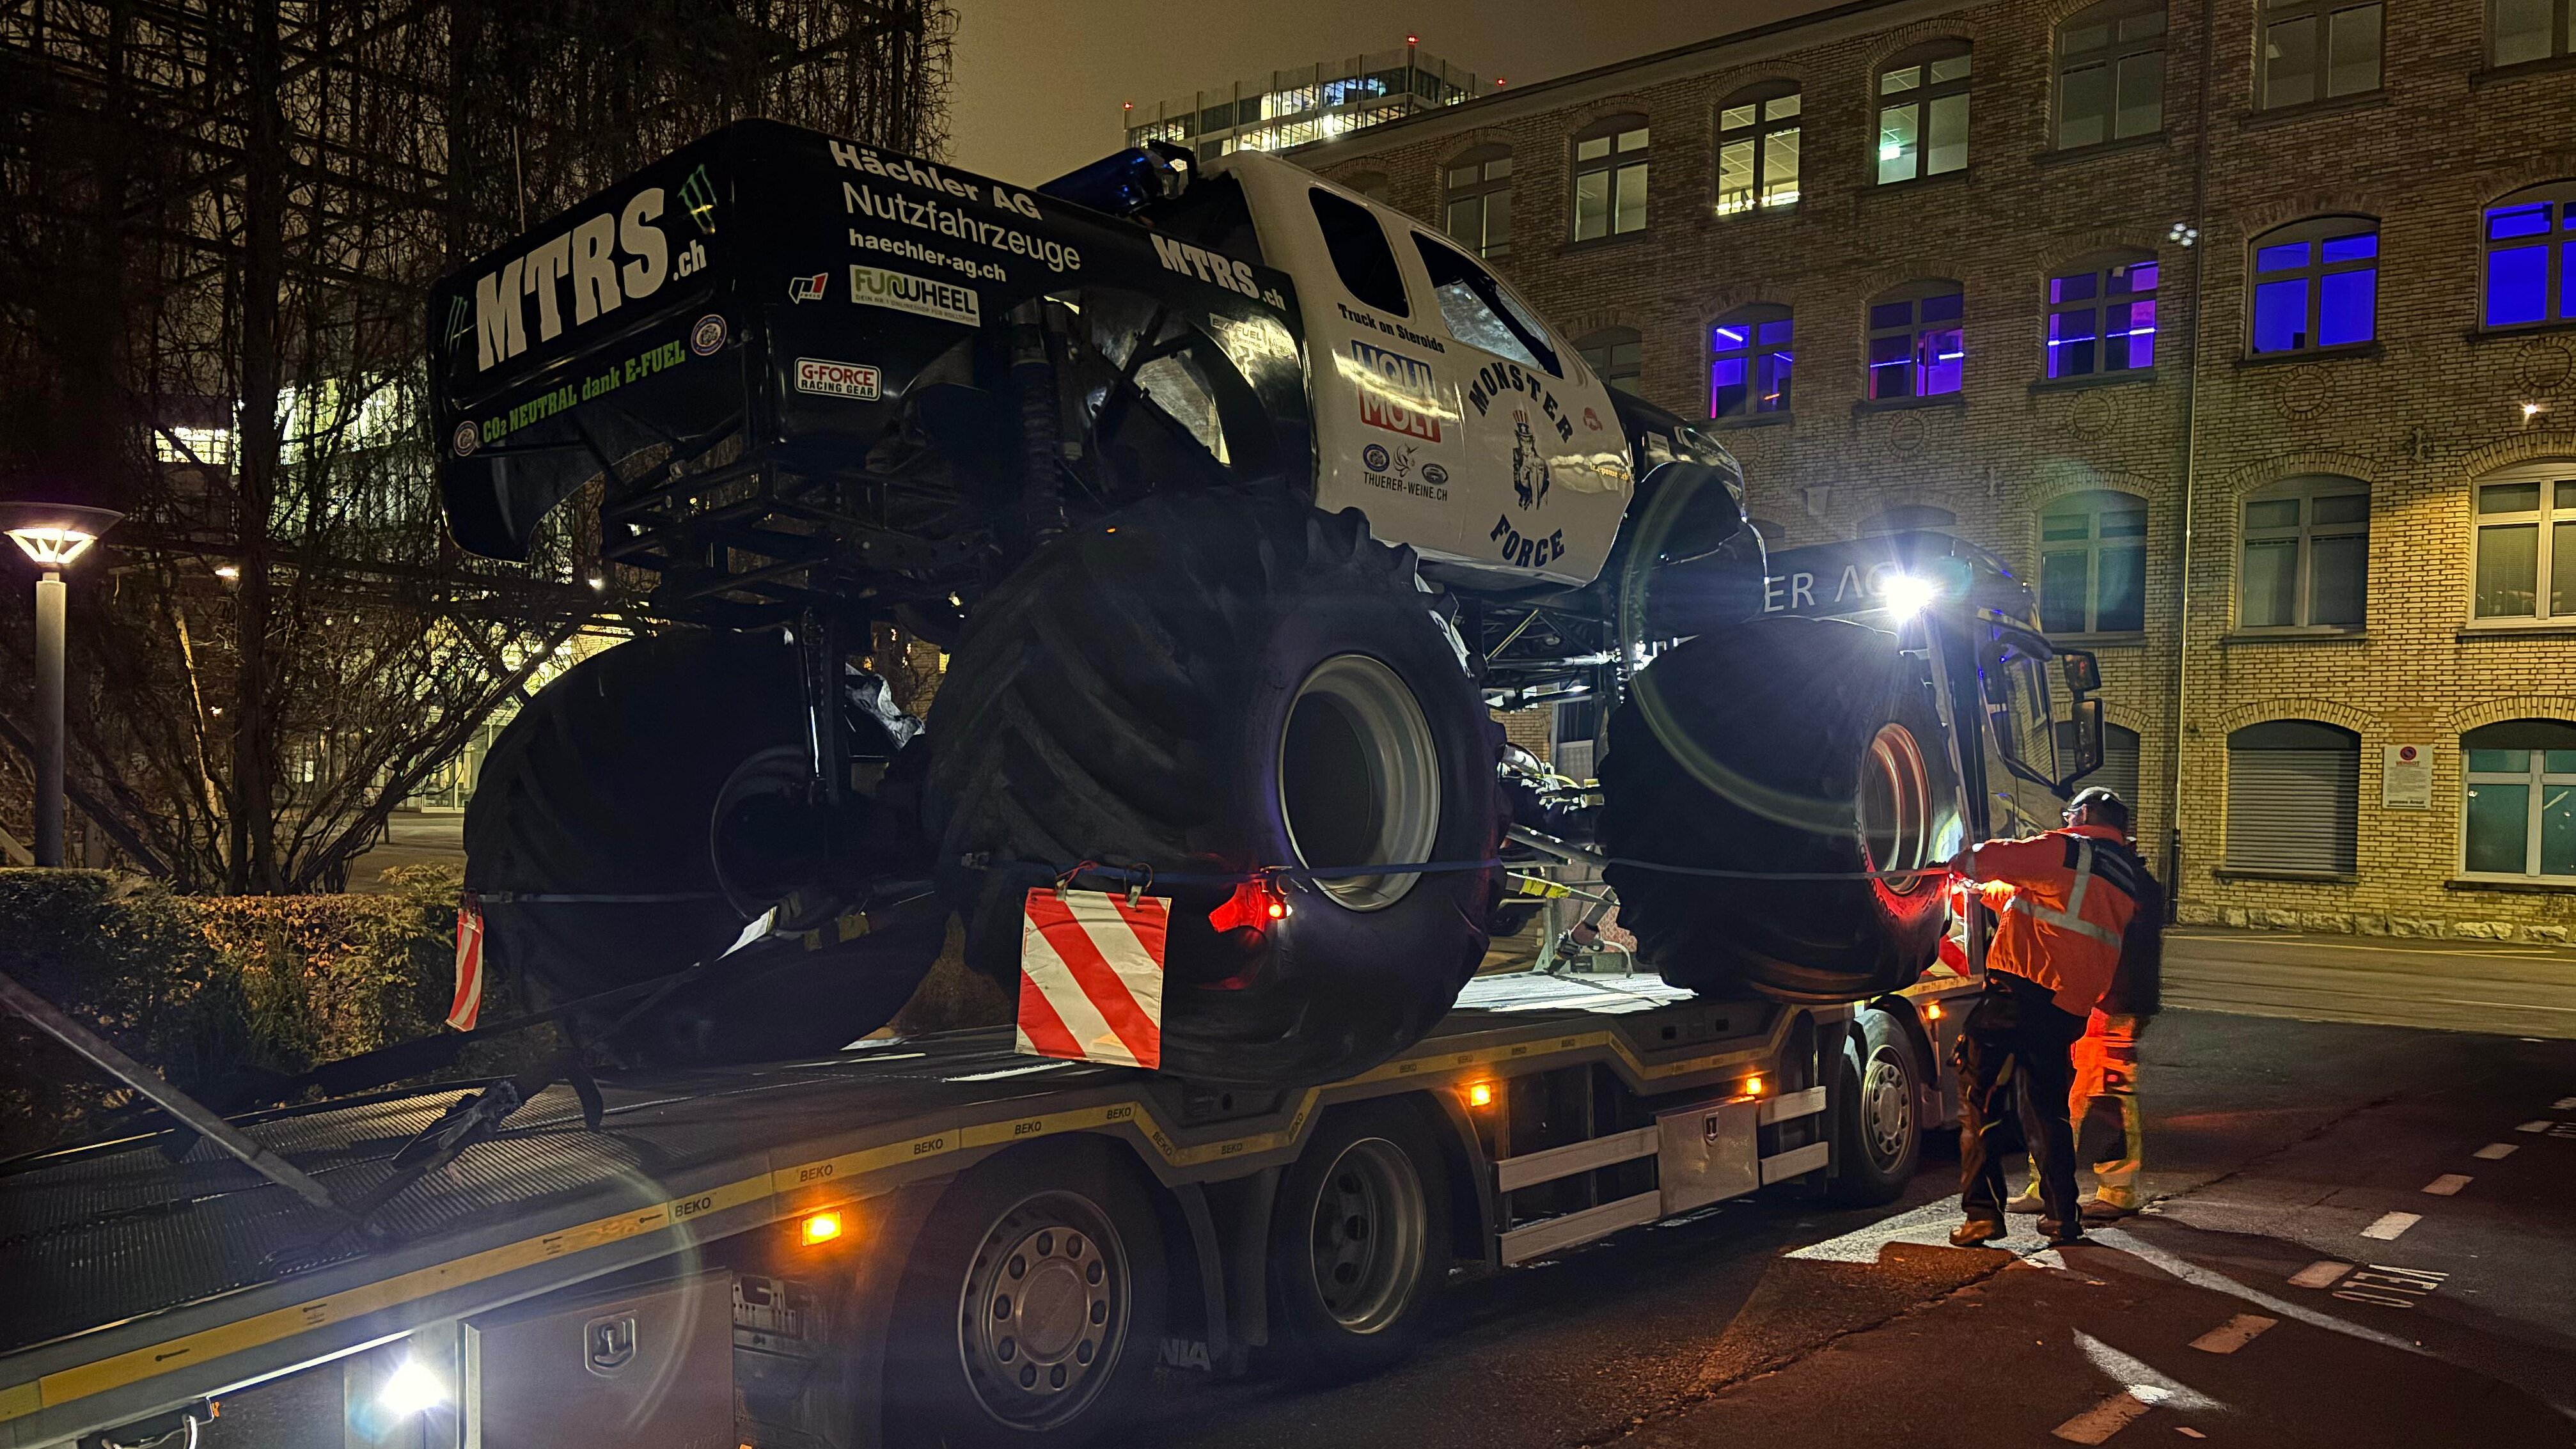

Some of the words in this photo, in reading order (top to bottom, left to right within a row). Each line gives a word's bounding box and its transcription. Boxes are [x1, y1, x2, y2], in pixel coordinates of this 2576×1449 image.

[829, 140, 979, 201] Hächler
[993, 186, 1042, 220] AG
[843, 182, 1081, 272] Nutzfahrzeuge
[849, 228, 1007, 282] haechler-ag.ch
[1151, 233, 1286, 311] MTRS.ch
[1337, 302, 1377, 329] Truck
[1379, 321, 1395, 336] on
[1396, 324, 1445, 354] Steroids
[510, 384, 577, 432] NEUTRAL
[582, 366, 620, 401] dank
[625, 340, 685, 384] E-FUEL
[801, 380, 842, 392] RACING
[846, 385, 874, 396] GEAR
[802, 364, 874, 387] G-FORCE
[1469, 362, 1573, 443] MONSTER
[1363, 472, 1448, 501] THUERER-WEINE.CH
[1490, 513, 1564, 568] FORCE
[1764, 573, 1815, 612] ER
[1015, 1121, 1042, 1135] BEKO
[1107, 1107, 1131, 1120] BEKO
[914, 1138, 943, 1155] BEKO
[1152, 1131, 1172, 1157] BEKO
[1221, 1143, 1243, 1155] BEKO
[799, 1164, 833, 1183] BEKO
[675, 1196, 711, 1218] BEKO
